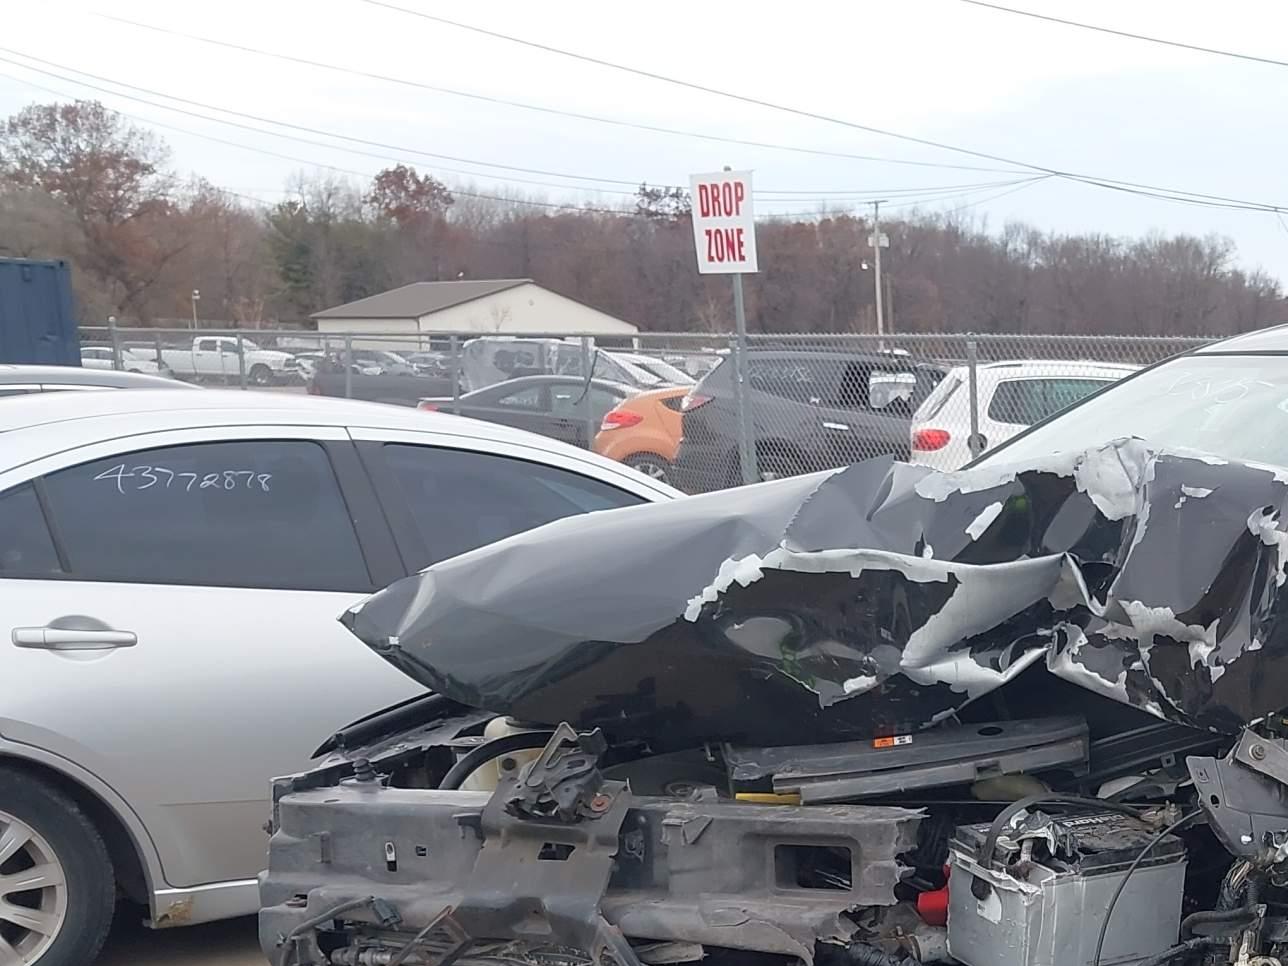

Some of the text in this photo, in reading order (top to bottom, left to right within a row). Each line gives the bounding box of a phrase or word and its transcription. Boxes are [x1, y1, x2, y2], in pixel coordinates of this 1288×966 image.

[698, 181, 744, 218] DROP
[704, 228, 746, 263] ZONE
[93, 463, 273, 495] 43772878
